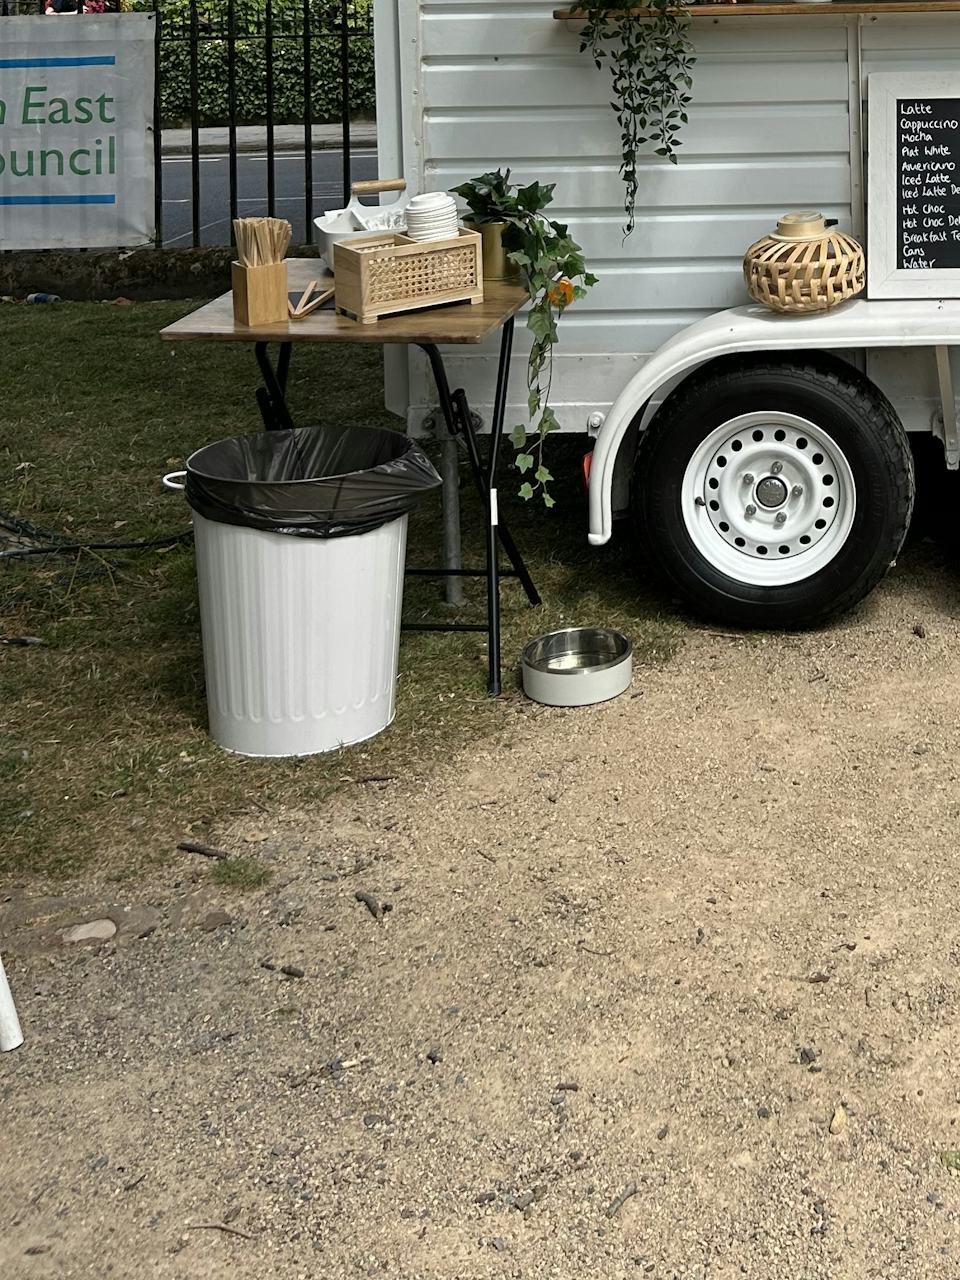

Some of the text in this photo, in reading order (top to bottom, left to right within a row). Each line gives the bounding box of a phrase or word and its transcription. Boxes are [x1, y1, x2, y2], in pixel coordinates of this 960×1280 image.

[21, 86, 116, 125] East
[900, 102, 933, 115] Latte
[900, 118, 959, 133] Cappuccino
[901, 131, 933, 142] Mocha
[924, 144, 951, 156] White
[0, 136, 116, 177] uncil
[901, 161, 956, 172] Americano
[902, 174, 922, 185] Iced
[925, 173, 951, 183] Latte
[902, 187, 919, 199] Iced
[922, 185, 947, 197] Latte
[902, 204, 919, 215] Hot
[922, 204, 946, 214] Choc
[902, 219, 917, 229] Hot
[923, 217, 945, 227] Choc
[903, 231, 947, 244] Breakfast
[902, 245, 925, 256] Cans
[903, 257, 936, 269] Water
